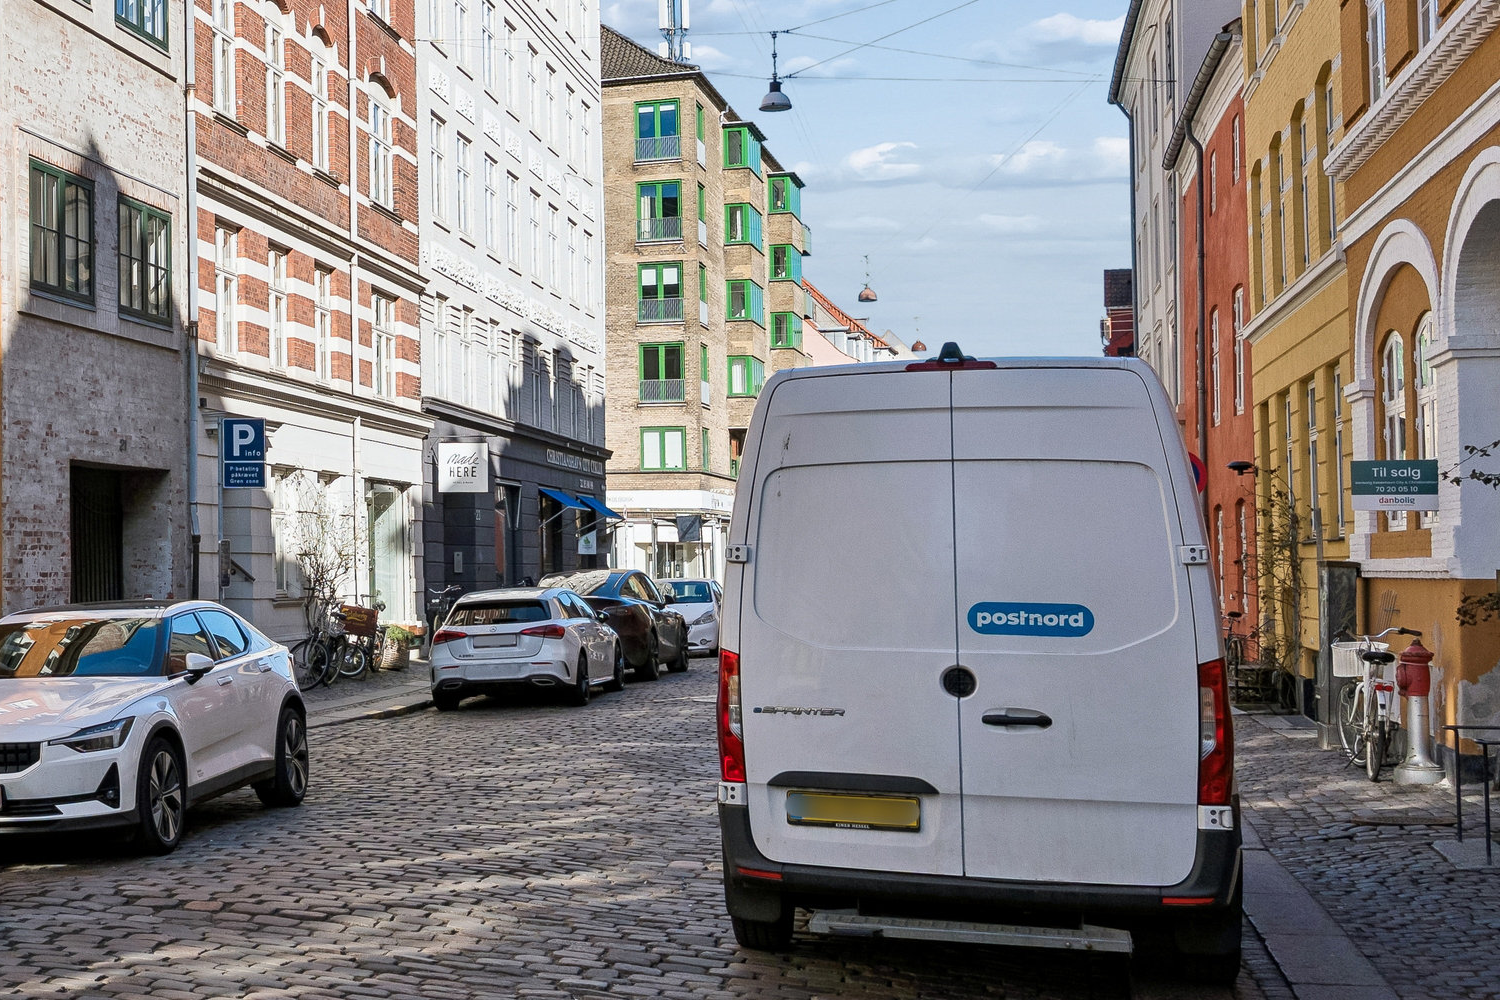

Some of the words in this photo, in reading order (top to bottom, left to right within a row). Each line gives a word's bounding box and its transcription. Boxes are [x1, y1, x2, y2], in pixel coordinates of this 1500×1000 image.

[232, 423, 256, 457] P
[244, 449, 262, 457] info
[449, 466, 478, 478] HERE
[1371, 467, 1387, 477] Til
[1390, 466, 1421, 480] salg
[1378, 496, 1416, 505] danbolig
[976, 610, 1084, 628] postnord
